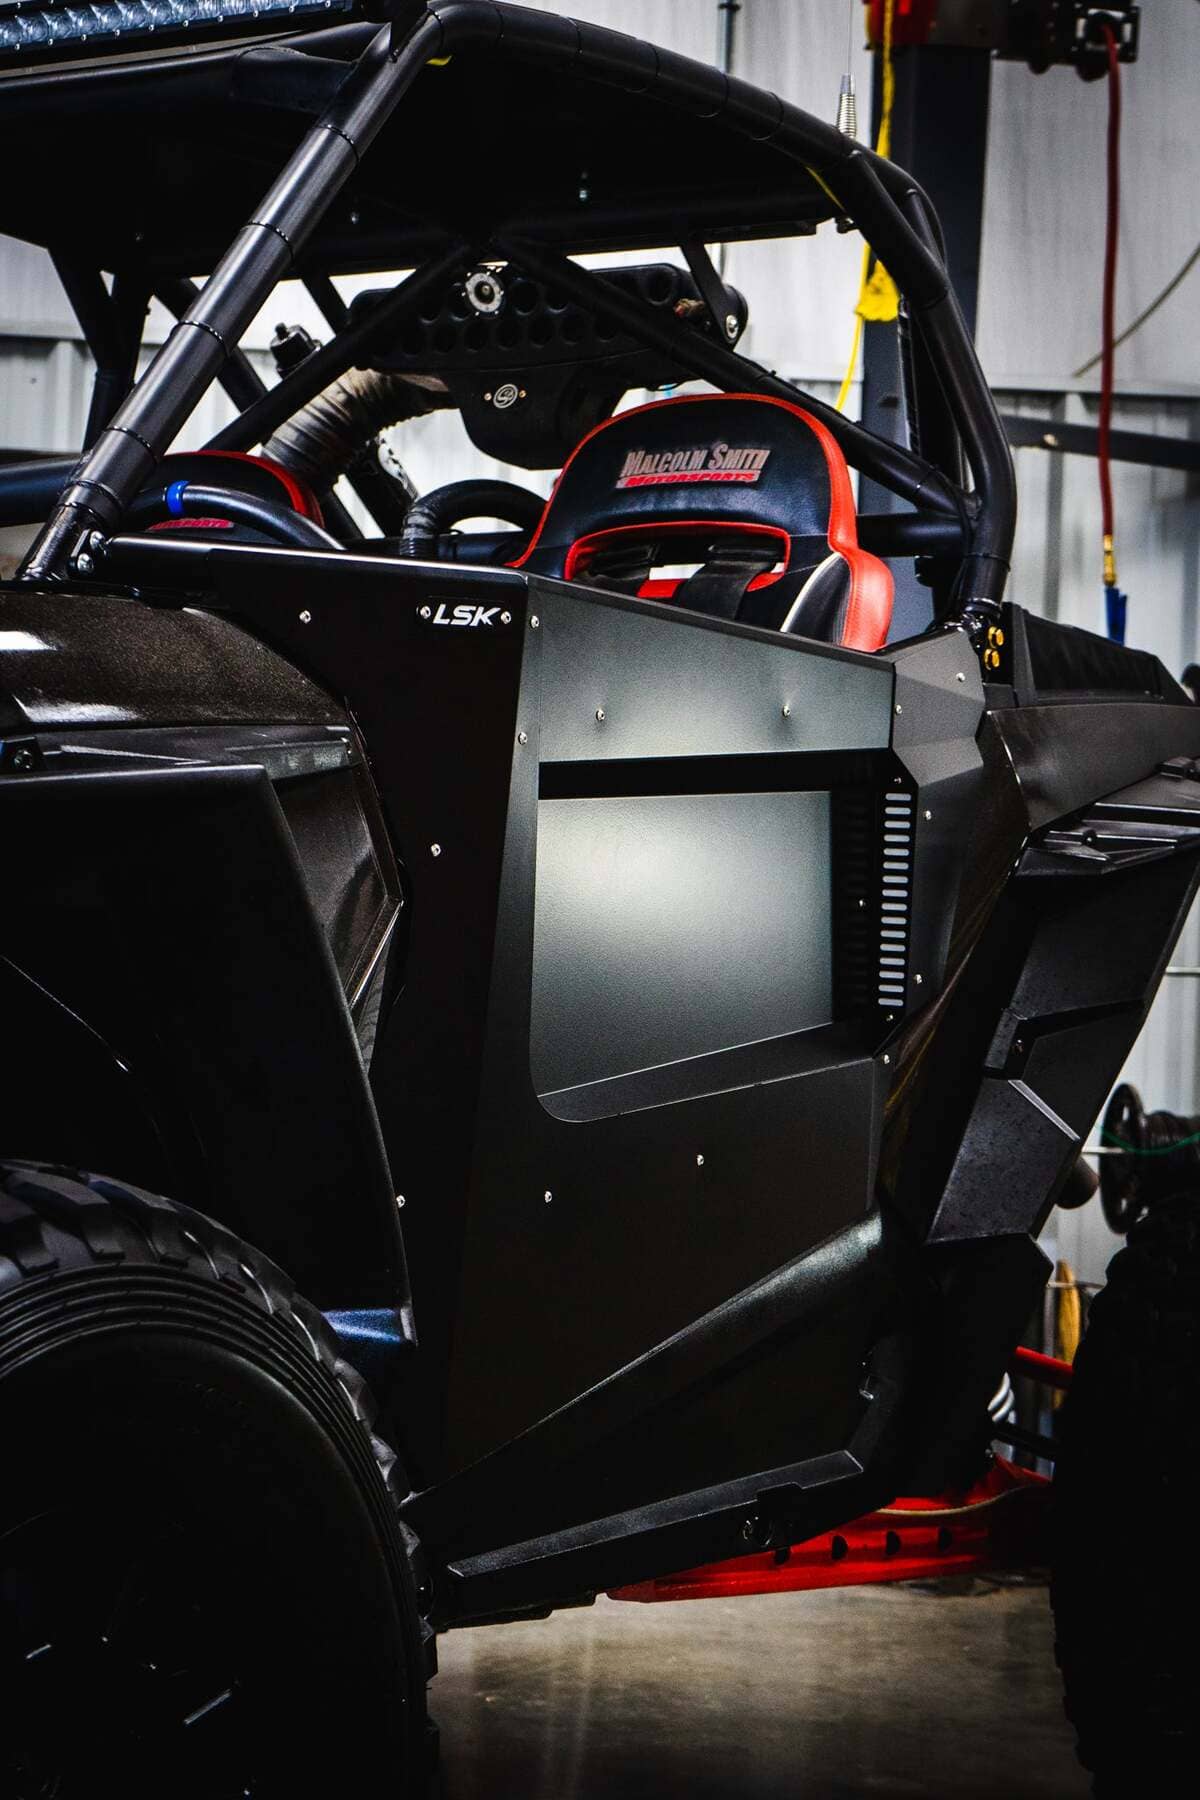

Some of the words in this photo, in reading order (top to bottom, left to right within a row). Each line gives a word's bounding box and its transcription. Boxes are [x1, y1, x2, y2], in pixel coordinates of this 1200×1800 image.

[619, 450, 708, 477] MALCOLM
[708, 443, 770, 470] SMITH
[624, 472, 755, 487] MOTORSPORTS
[432, 603, 501, 627] LSK
